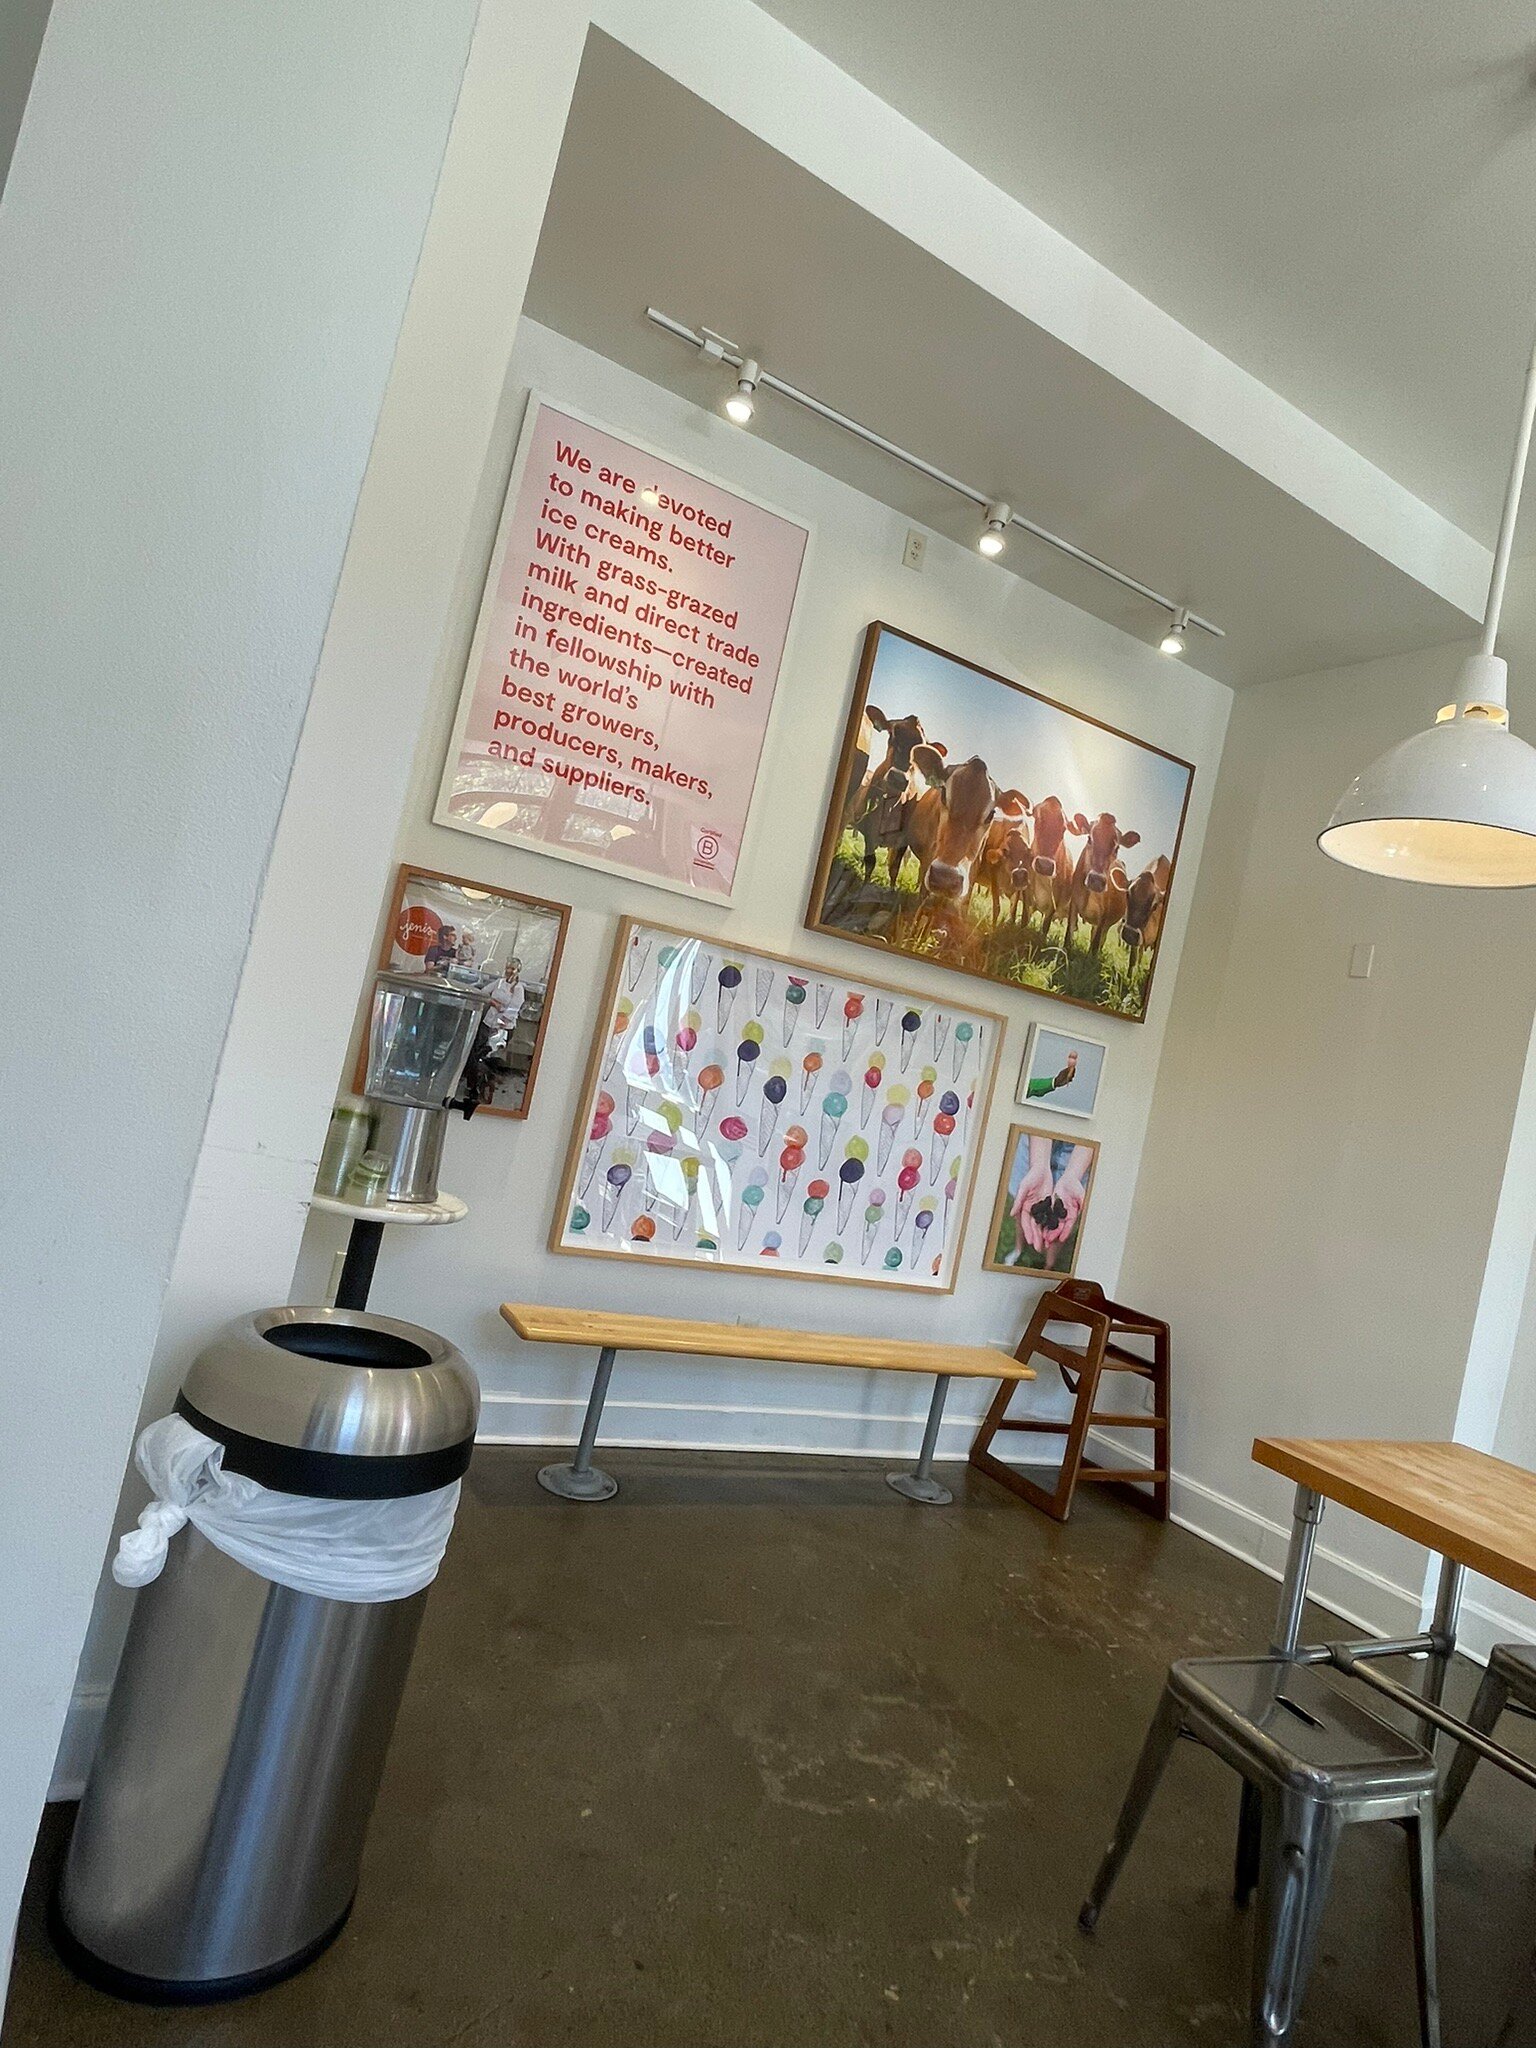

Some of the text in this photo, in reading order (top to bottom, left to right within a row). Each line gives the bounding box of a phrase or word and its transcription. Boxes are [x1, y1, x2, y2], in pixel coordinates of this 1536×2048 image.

[557, 441, 591, 473] We
[599, 467, 635, 493] are
[541, 498, 672, 573] ice creams.
[550, 473, 735, 568] to making better
[528, 563, 759, 667] milk and direct trade
[537, 528, 738, 630] With grass-grazed
[510, 648, 550, 677] the
[515, 616, 714, 709] in fellowship with
[502, 675, 658, 751] best growers,
[488, 741, 650, 805] and suppliers.
[494, 710, 712, 799] producers, makers,
